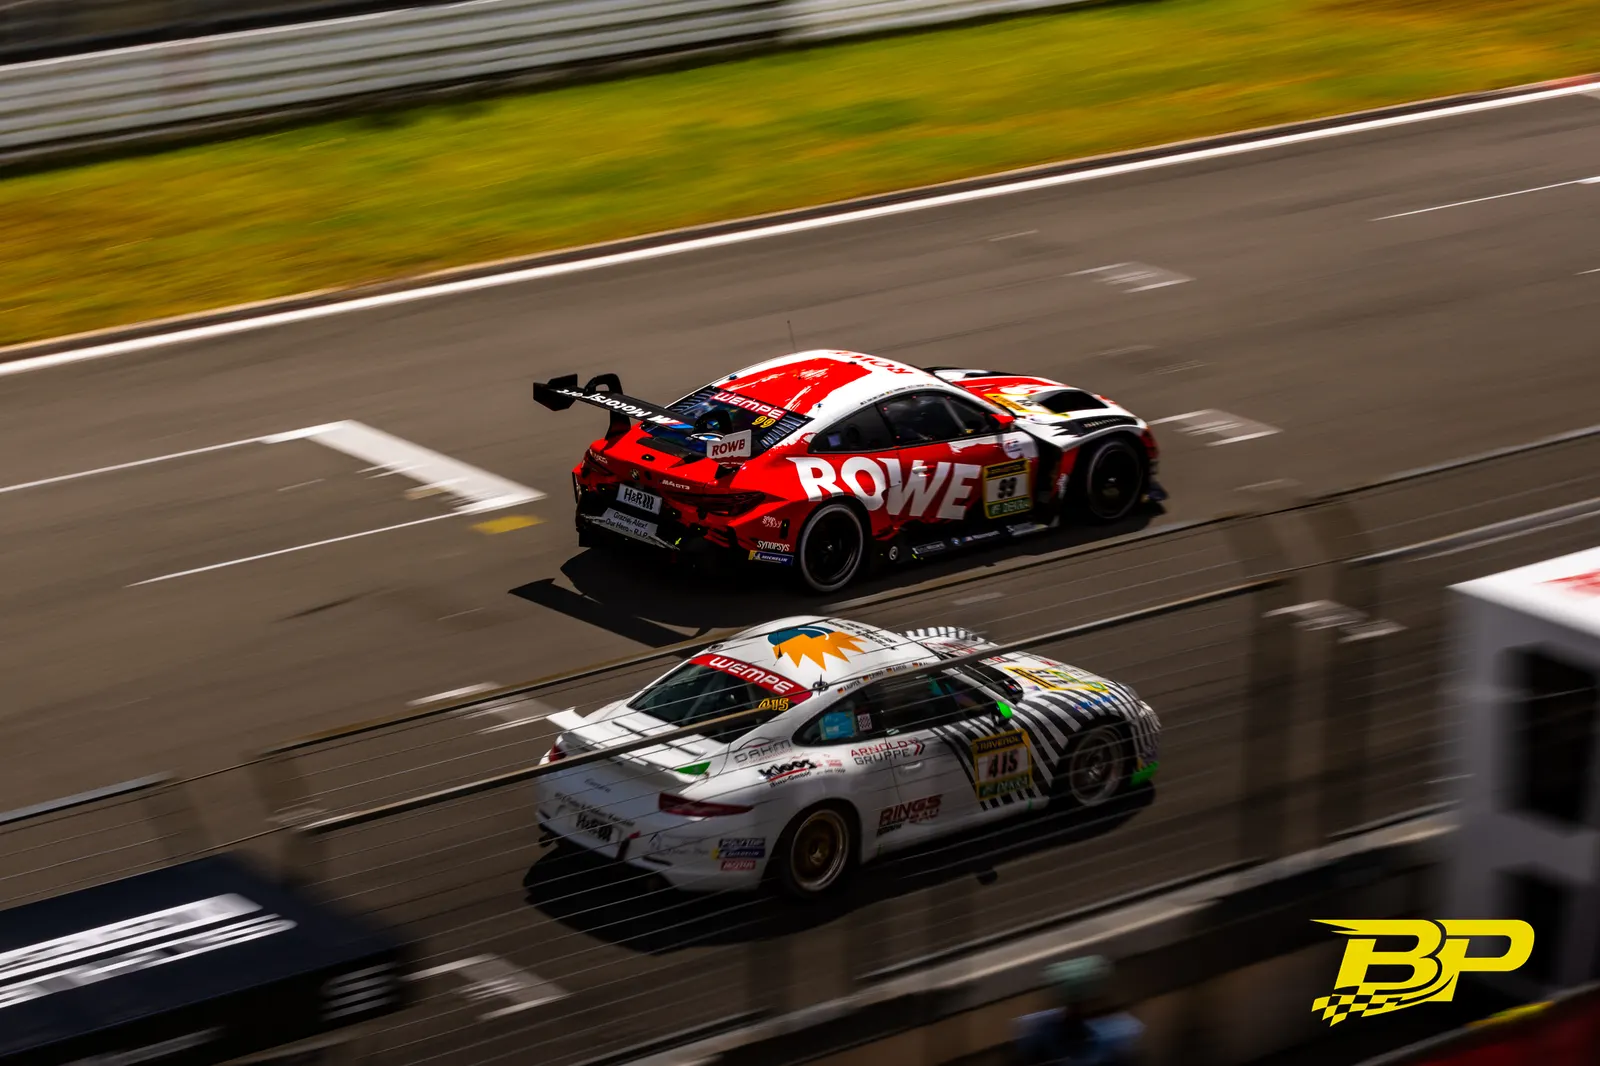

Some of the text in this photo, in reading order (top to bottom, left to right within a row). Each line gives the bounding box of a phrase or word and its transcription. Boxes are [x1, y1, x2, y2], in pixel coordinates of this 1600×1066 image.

[556, 389, 651, 417] Motorsport
[714, 392, 784, 419] WEMPE
[752, 415, 776, 428] 99
[785, 455, 982, 520] ROWE
[709, 657, 794, 693] WEMPE
[850, 740, 908, 757] ARNOLD
[853, 748, 911, 765] GRUPPE
[987, 749, 1019, 778] 415
[879, 794, 943, 827] RINGS
